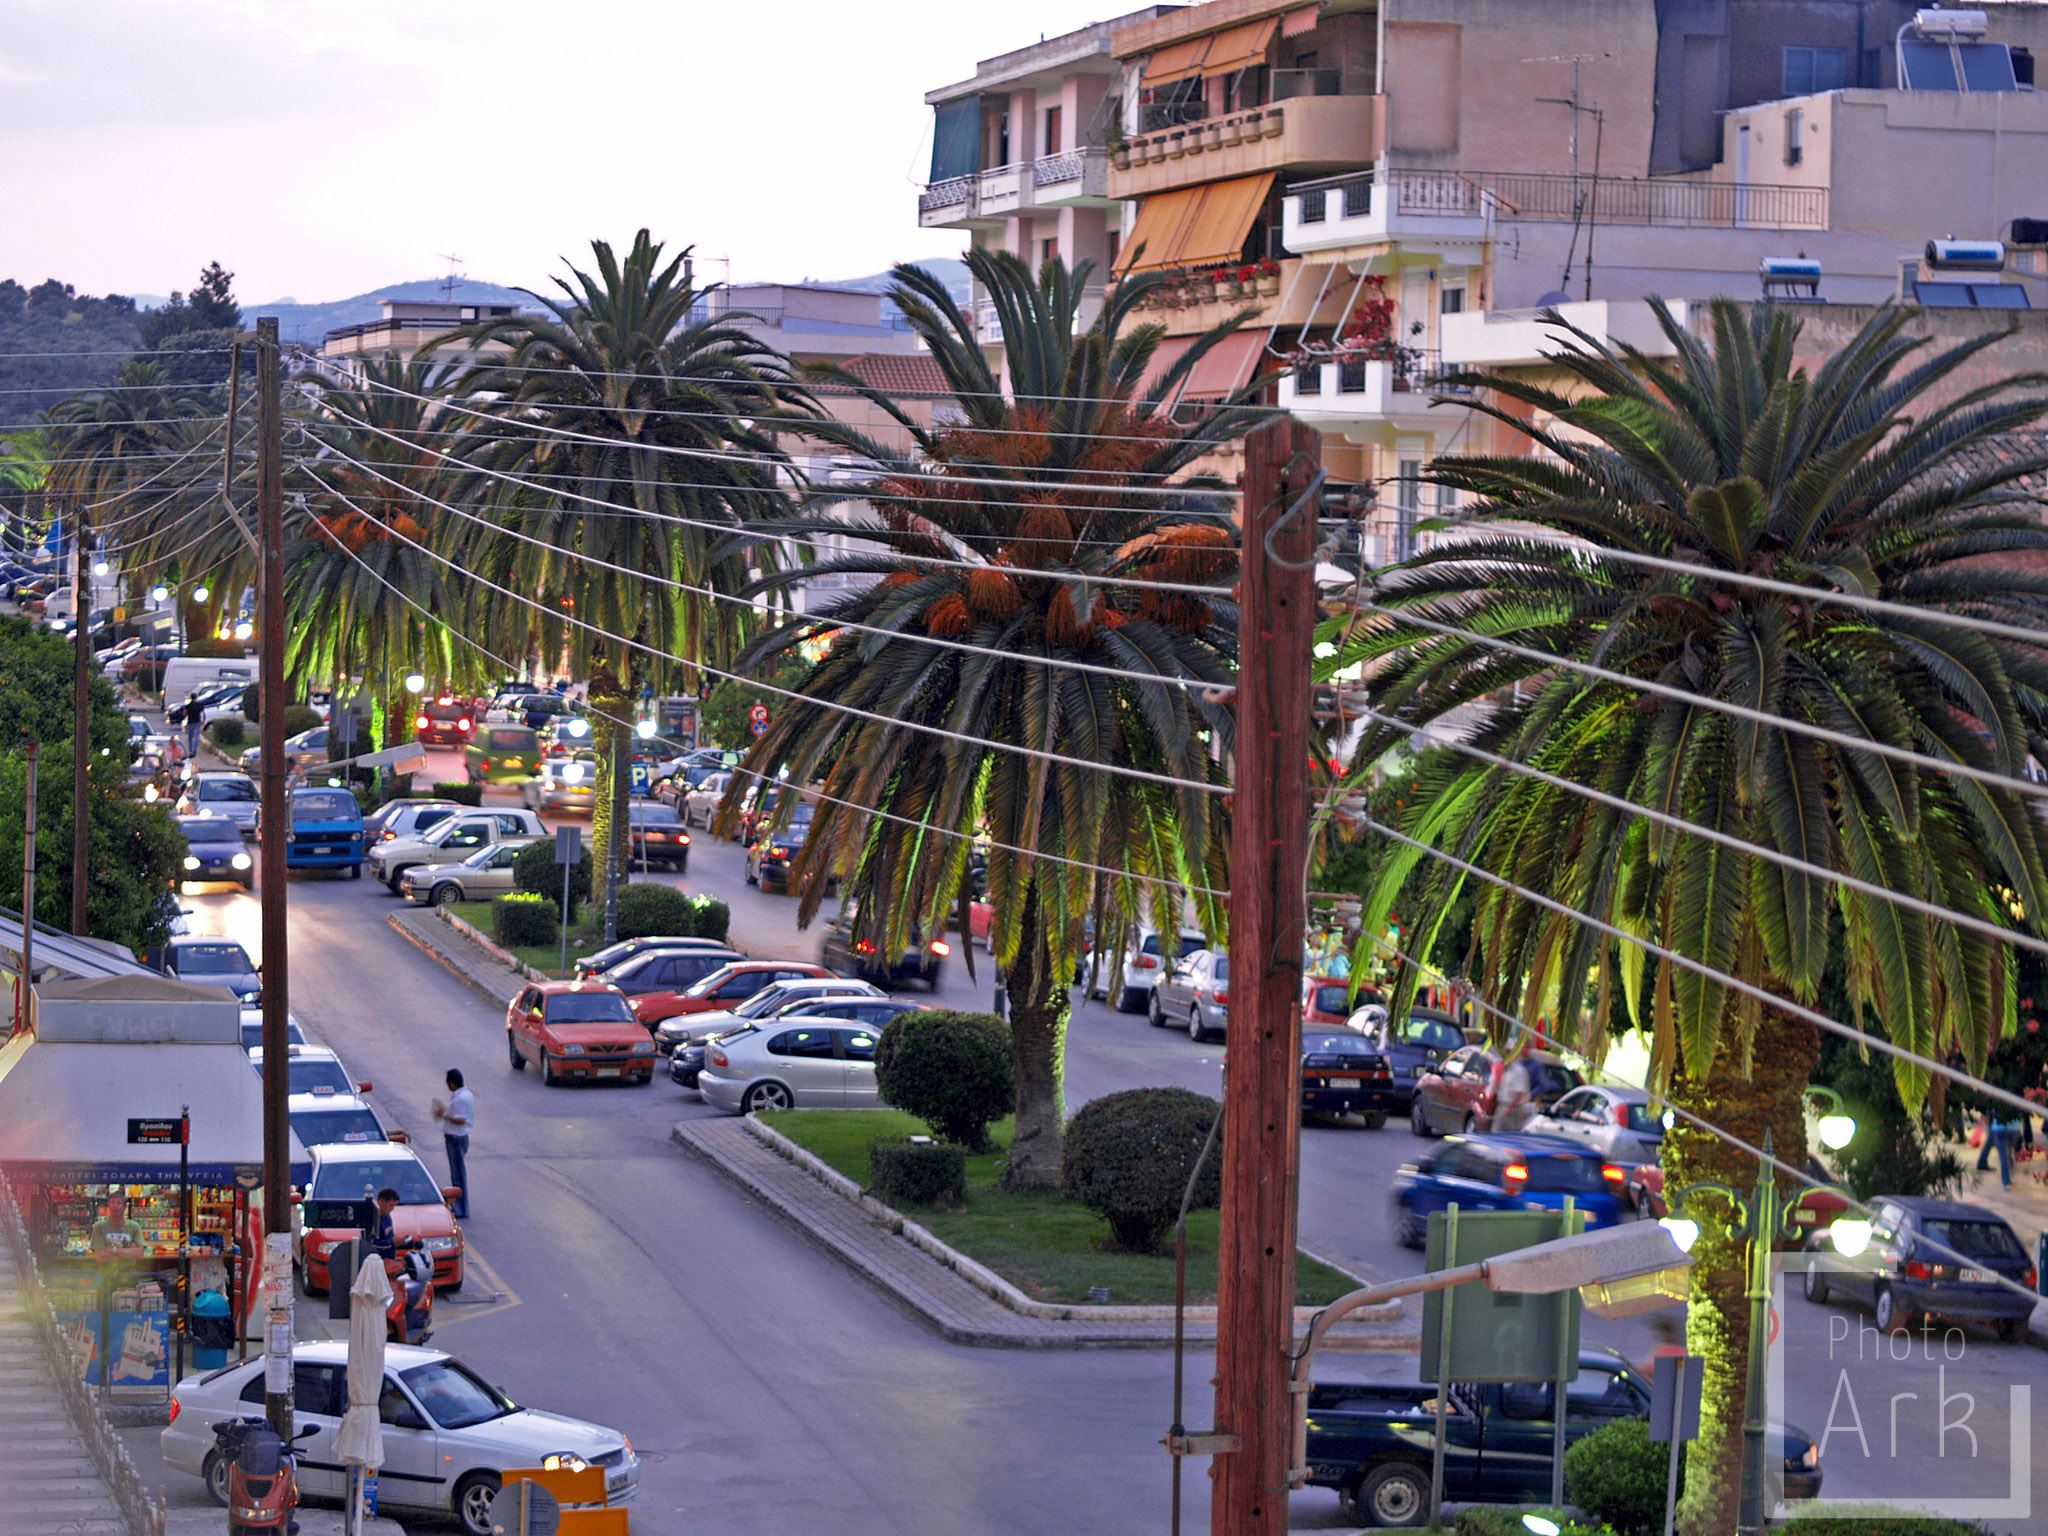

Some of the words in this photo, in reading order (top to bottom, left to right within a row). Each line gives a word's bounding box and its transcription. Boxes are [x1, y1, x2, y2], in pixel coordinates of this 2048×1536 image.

[632, 767, 647, 786] P
[103, 1171, 151, 1179] ΣΟΒΑΡΑ
[188, 1171, 223, 1179] ΥΓΕΙΑ
